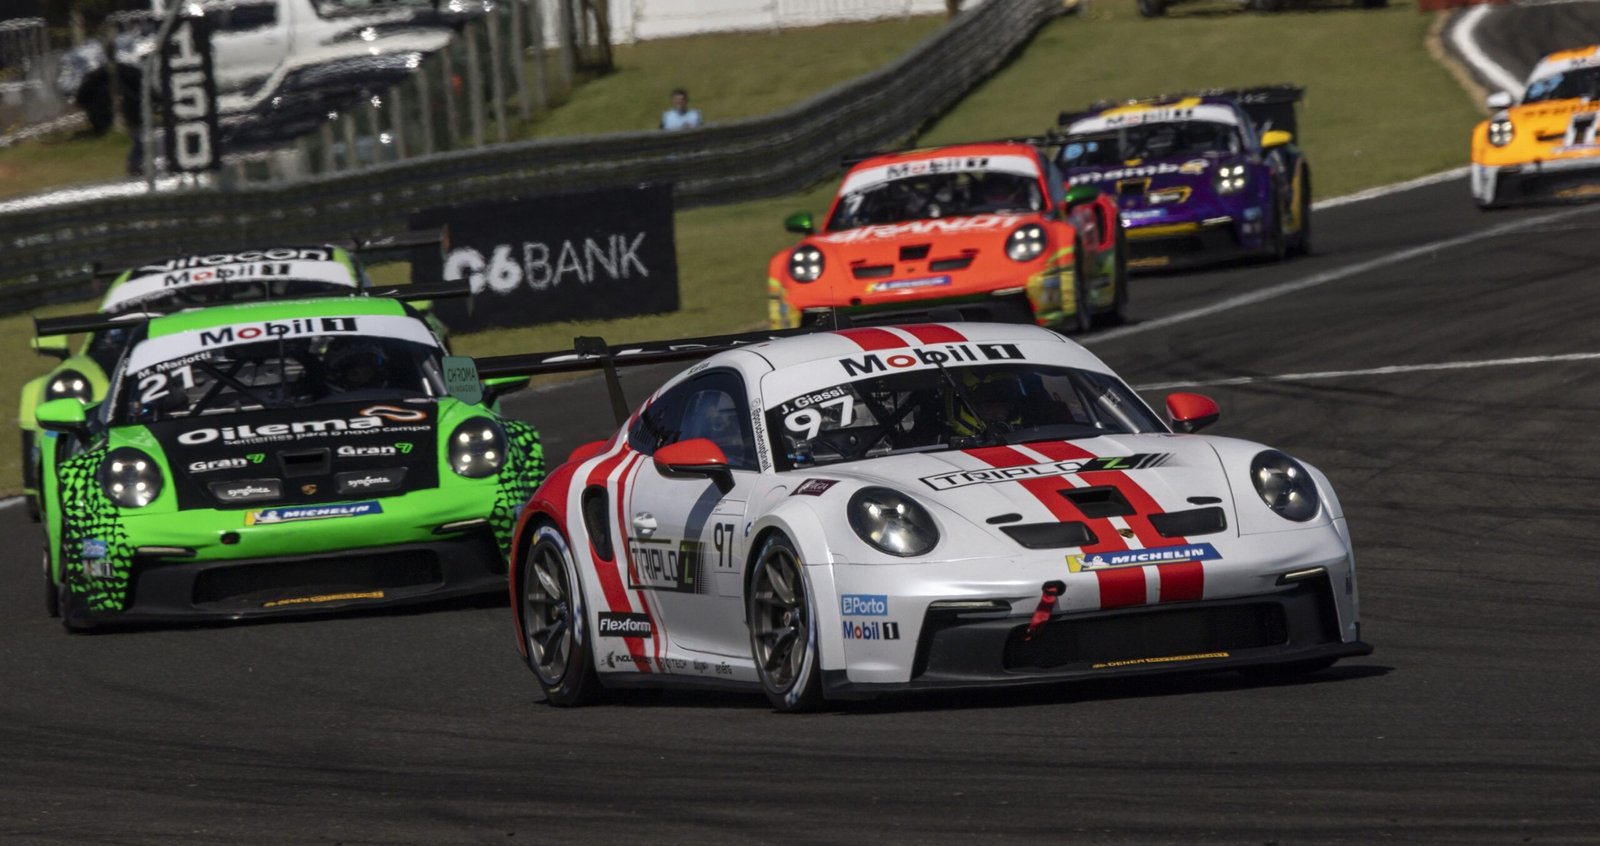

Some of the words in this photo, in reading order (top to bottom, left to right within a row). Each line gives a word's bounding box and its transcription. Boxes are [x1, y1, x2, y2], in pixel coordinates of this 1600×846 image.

[169, 20, 211, 169] 150
[164, 263, 254, 288] Mobil
[200, 319, 314, 346] Mobil
[321, 317, 358, 333] 1
[138, 368, 158, 380] M.
[156, 352, 212, 374] Mariotti
[839, 345, 978, 377] Mobil
[137, 367, 196, 405] 21
[781, 403, 796, 416] J.
[798, 386, 845, 409] Giassi
[178, 416, 384, 445] Oilema
[784, 394, 856, 442] 97
[296, 430, 327, 442] para
[381, 424, 432, 434] campo
[227, 485, 271, 497] syngenta
[347, 476, 391, 487] syngenta
[283, 504, 371, 518] MICHELIN
[714, 522, 735, 568] 97
[1111, 548, 1204, 564] MICHELIN
[600, 618, 652, 632] Flexform
[843, 620, 880, 640] Mobil
[882, 621, 900, 640] 1
